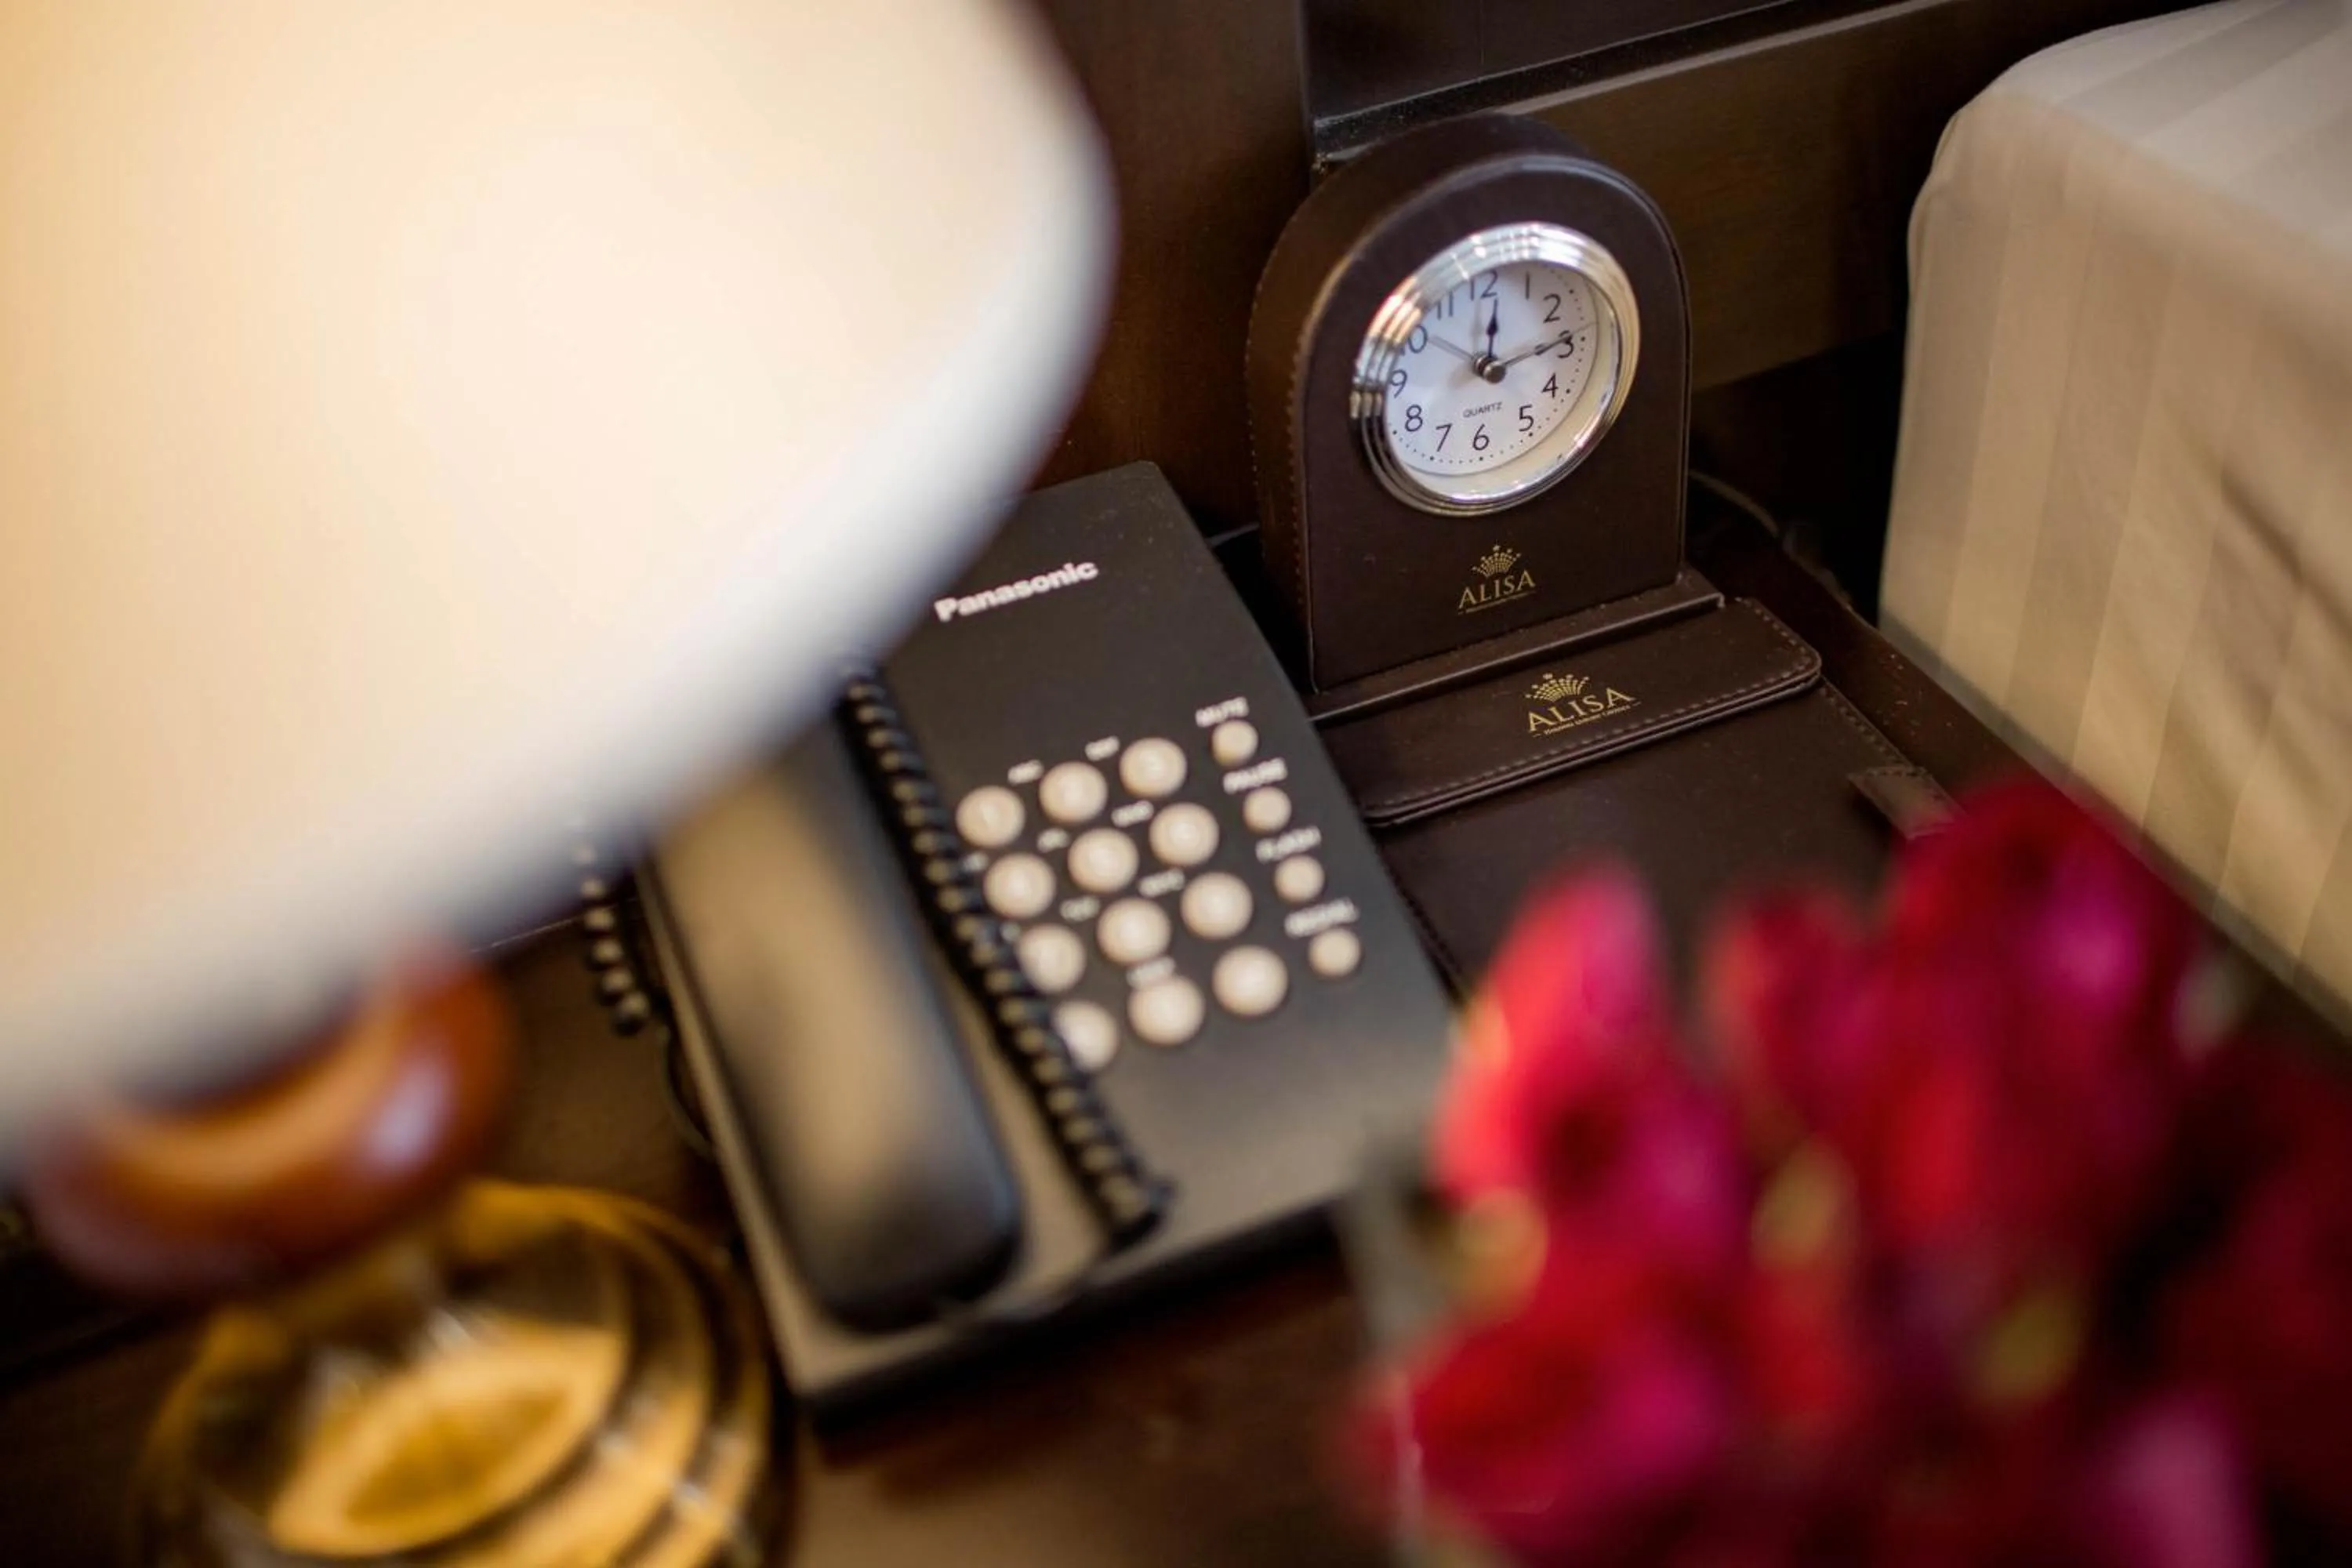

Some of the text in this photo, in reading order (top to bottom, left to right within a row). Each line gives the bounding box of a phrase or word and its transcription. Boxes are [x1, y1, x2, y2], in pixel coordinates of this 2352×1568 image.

[1469, 268, 1498, 301] 12
[1524, 270, 1530, 299] 1
[1543, 293, 1562, 324] 2
[1557, 329, 1574, 359] 3
[1391, 368, 1408, 398] 9
[1541, 372, 1559, 398] 4
[1404, 404, 1423, 432] 8
[1462, 401, 1503, 418] QUARTZ
[1519, 404, 1534, 432] 5
[1436, 423, 1453, 452] 7
[1472, 423, 1490, 451] 6
[934, 561, 1099, 622] Panasonic
[1458, 570, 1536, 609] ALISA
[1529, 688, 1636, 733] ALISA
